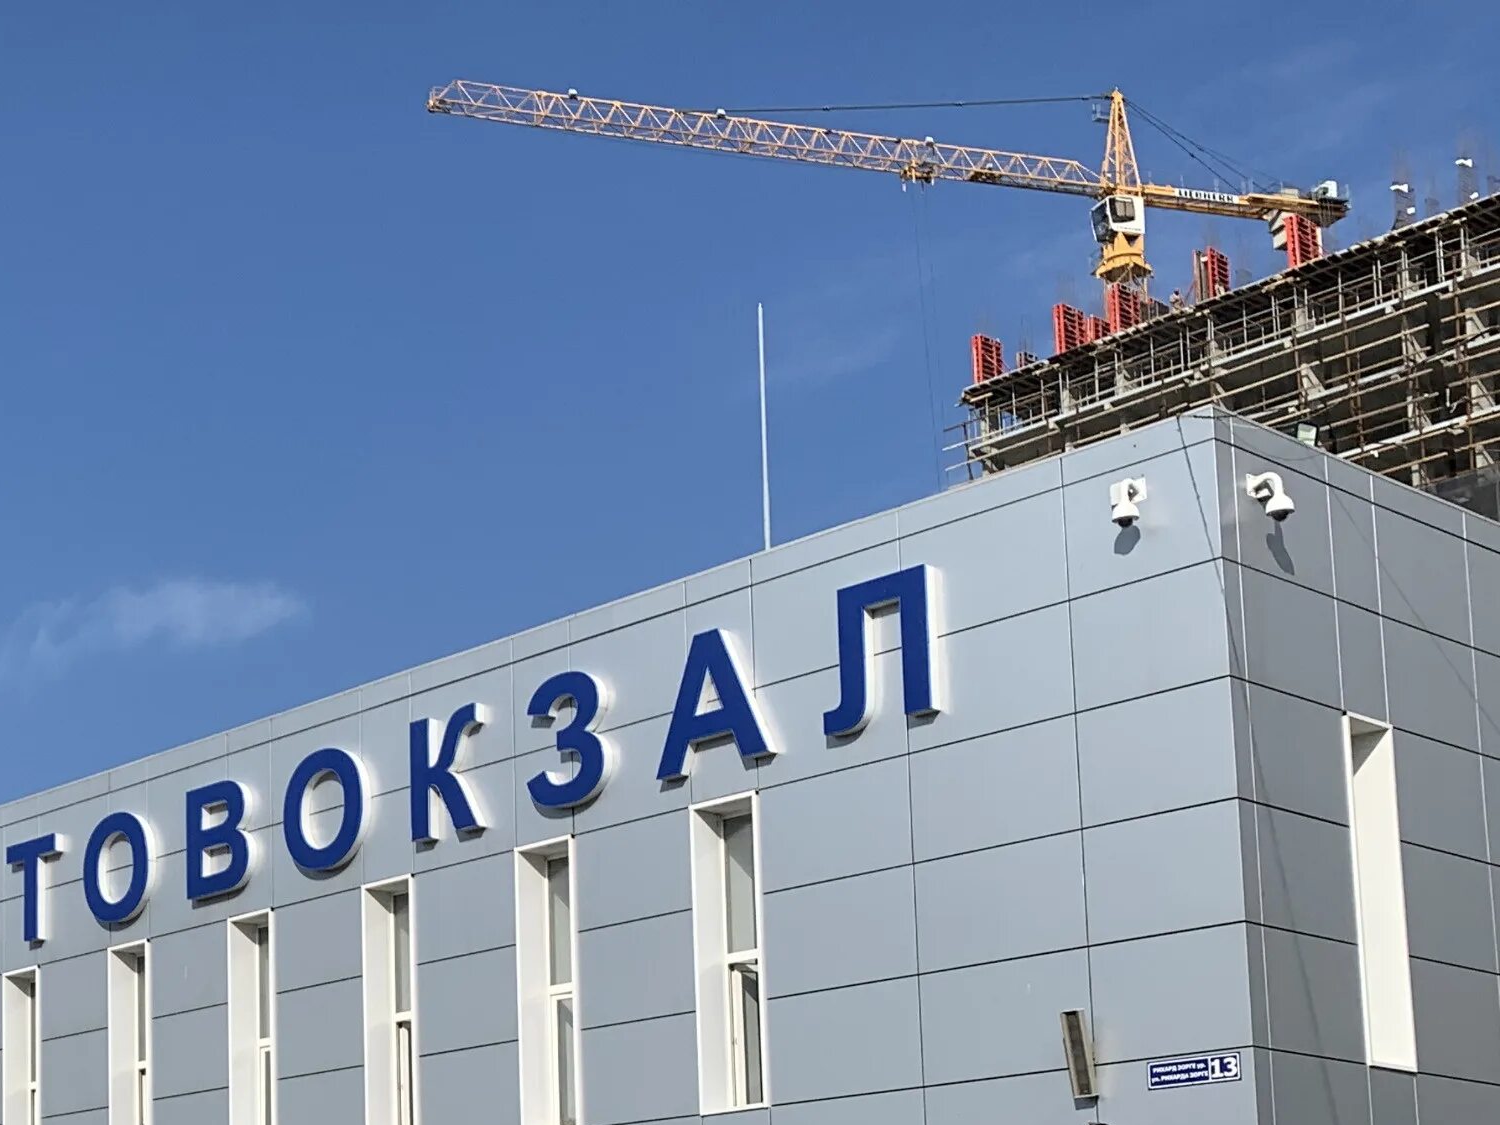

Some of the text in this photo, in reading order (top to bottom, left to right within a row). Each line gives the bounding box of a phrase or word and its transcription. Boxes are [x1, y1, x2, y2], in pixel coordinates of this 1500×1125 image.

[1178, 1062, 1196, 1071] ЗОРГЕ
[1211, 1056, 1238, 1078] 13
[1161, 1073, 1189, 1081] РИХАРДА
[1189, 1070, 1209, 1078] ЗОРГЕ
